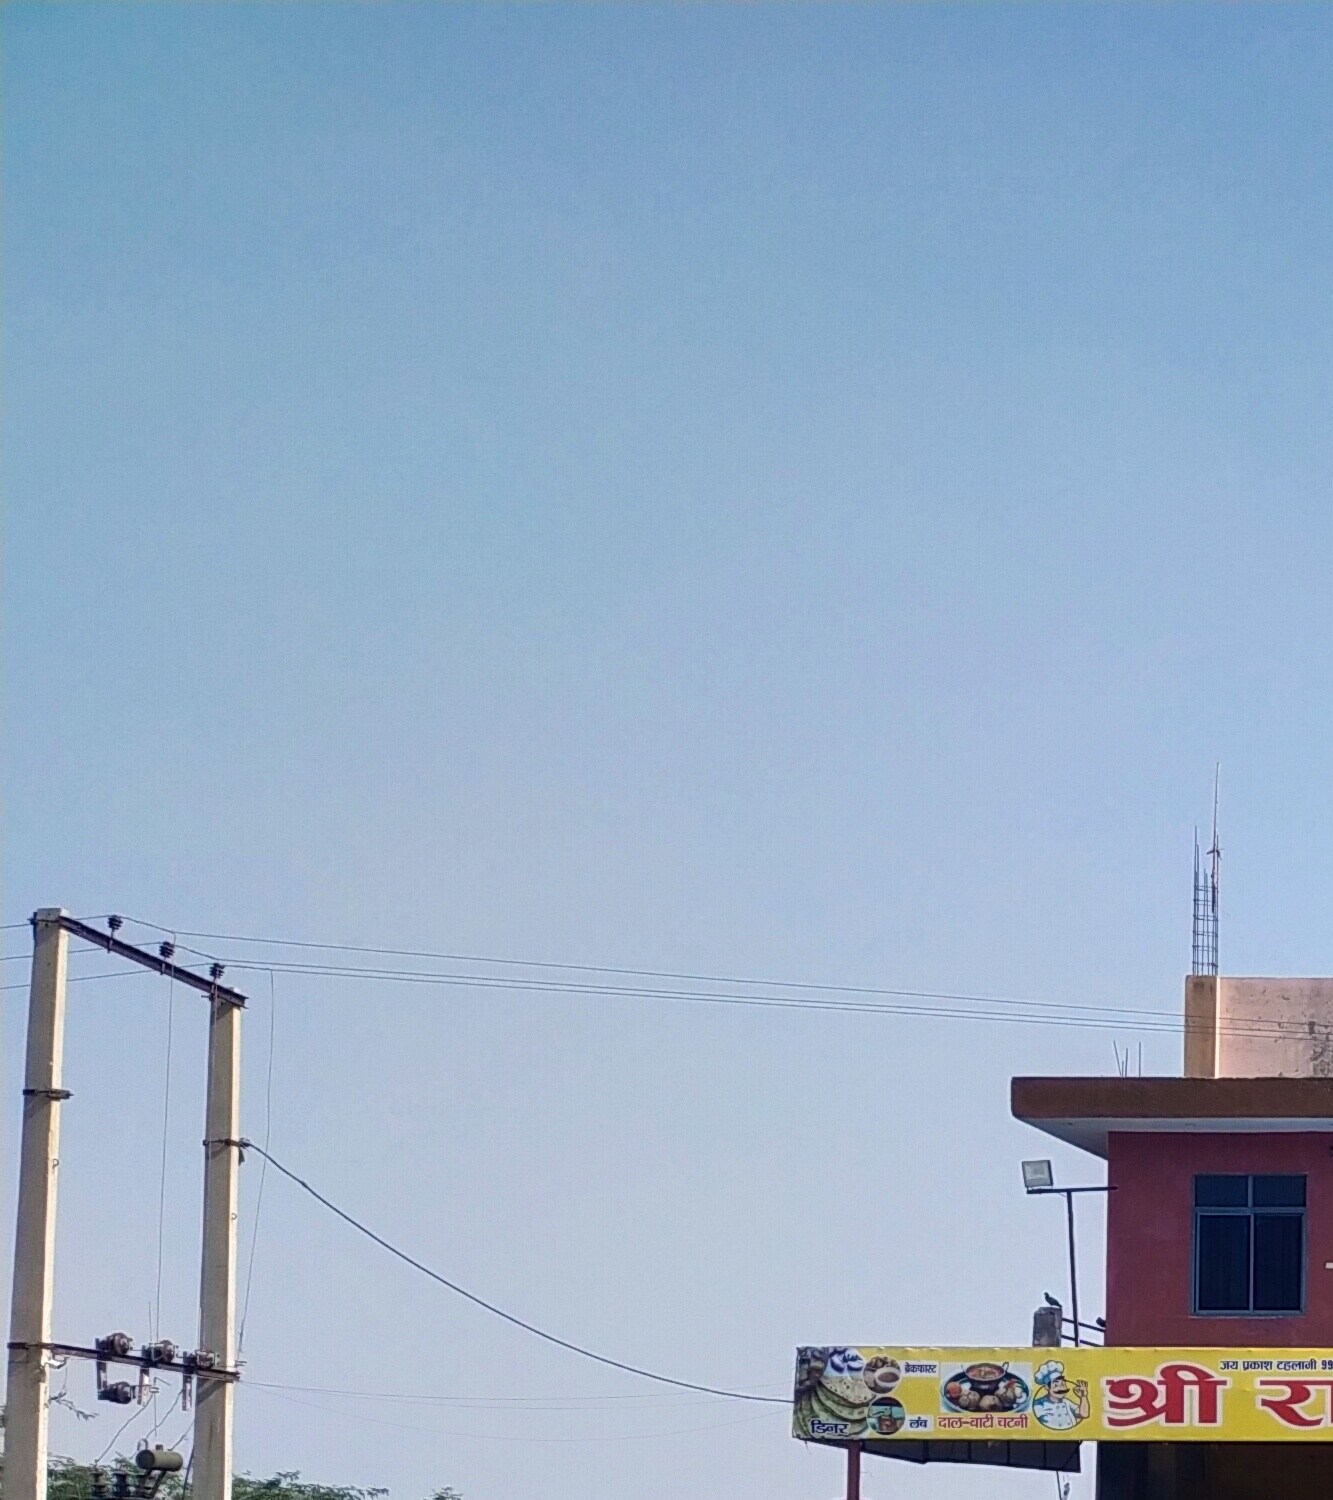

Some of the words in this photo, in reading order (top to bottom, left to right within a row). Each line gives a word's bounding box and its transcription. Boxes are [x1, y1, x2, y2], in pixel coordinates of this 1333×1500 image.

[1220, 1360, 1238, 1370] जय
[1242, 1360, 1272, 1371] प्रकाश
[1276, 1358, 1316, 1371] टहलानी
[1106, 1365, 1227, 1427] श्री
[811, 1420, 849, 1435] डिनर
[909, 1416, 928, 1429] लंच
[997, 1414, 1028, 1429] चटनी
